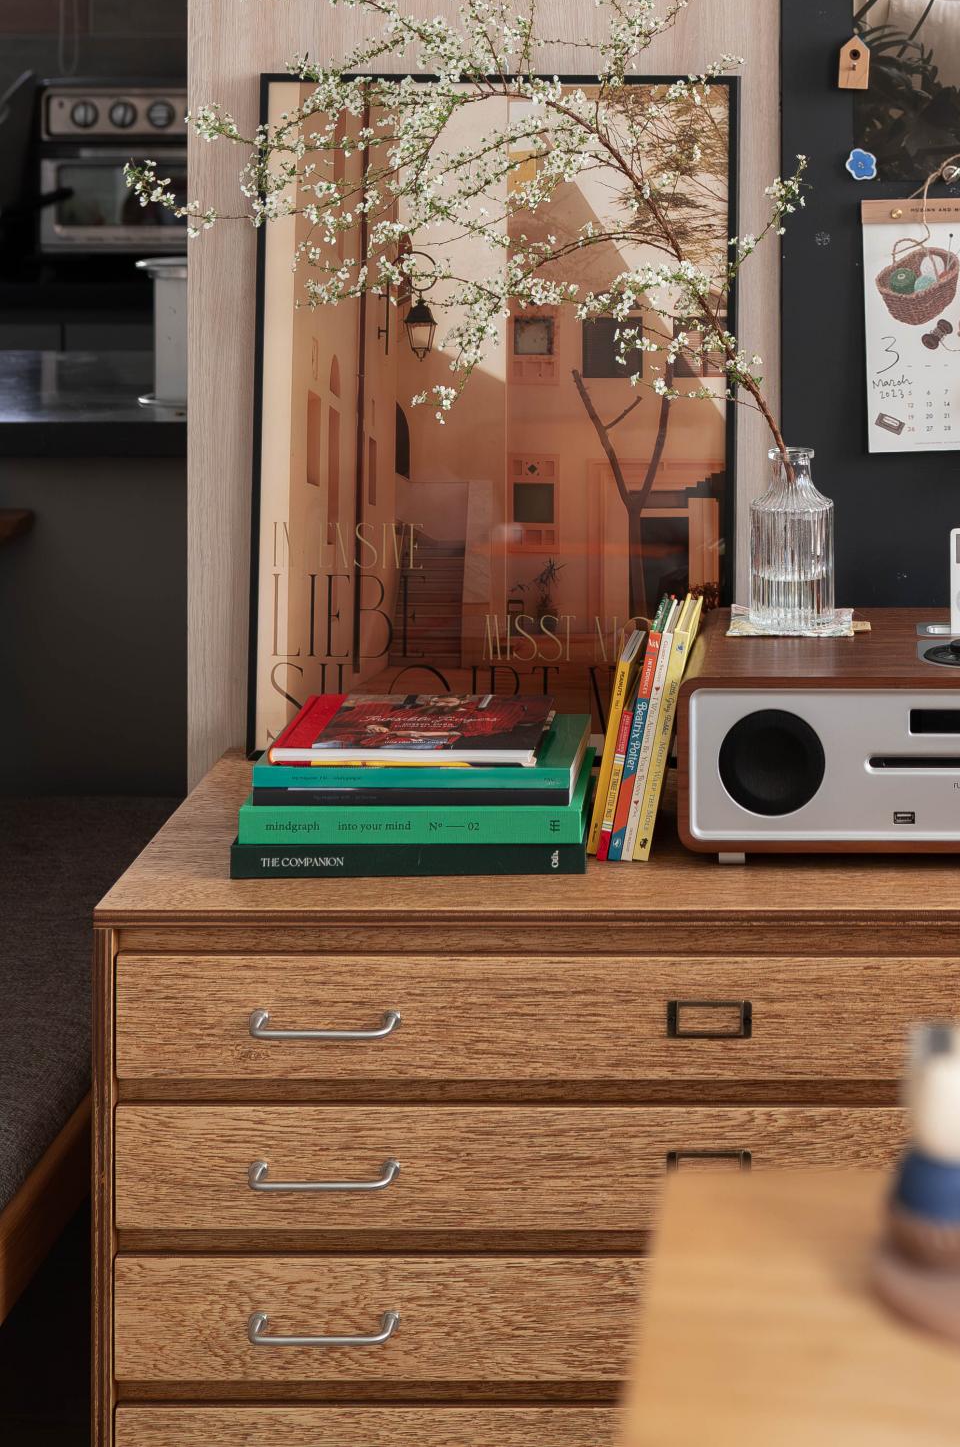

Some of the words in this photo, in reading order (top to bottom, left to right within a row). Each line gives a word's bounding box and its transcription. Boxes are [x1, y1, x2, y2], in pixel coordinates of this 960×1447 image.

[877, 337, 899, 374] 3
[873, 375, 912, 389] March
[880, 389, 904, 399] 2023
[272, 522, 424, 569] INENSIVE
[271, 573, 426, 658] LIEBE
[631, 701, 647, 738] Beatrix
[626, 741, 641, 770] Potter
[265, 822, 320, 833] mindgraph
[338, 822, 358, 831] into
[360, 823, 382, 833] your
[385, 821, 411, 831] mind
[468, 822, 480, 831] 02
[261, 857, 280, 867] THE
[282, 856, 344, 867] COMPANION
